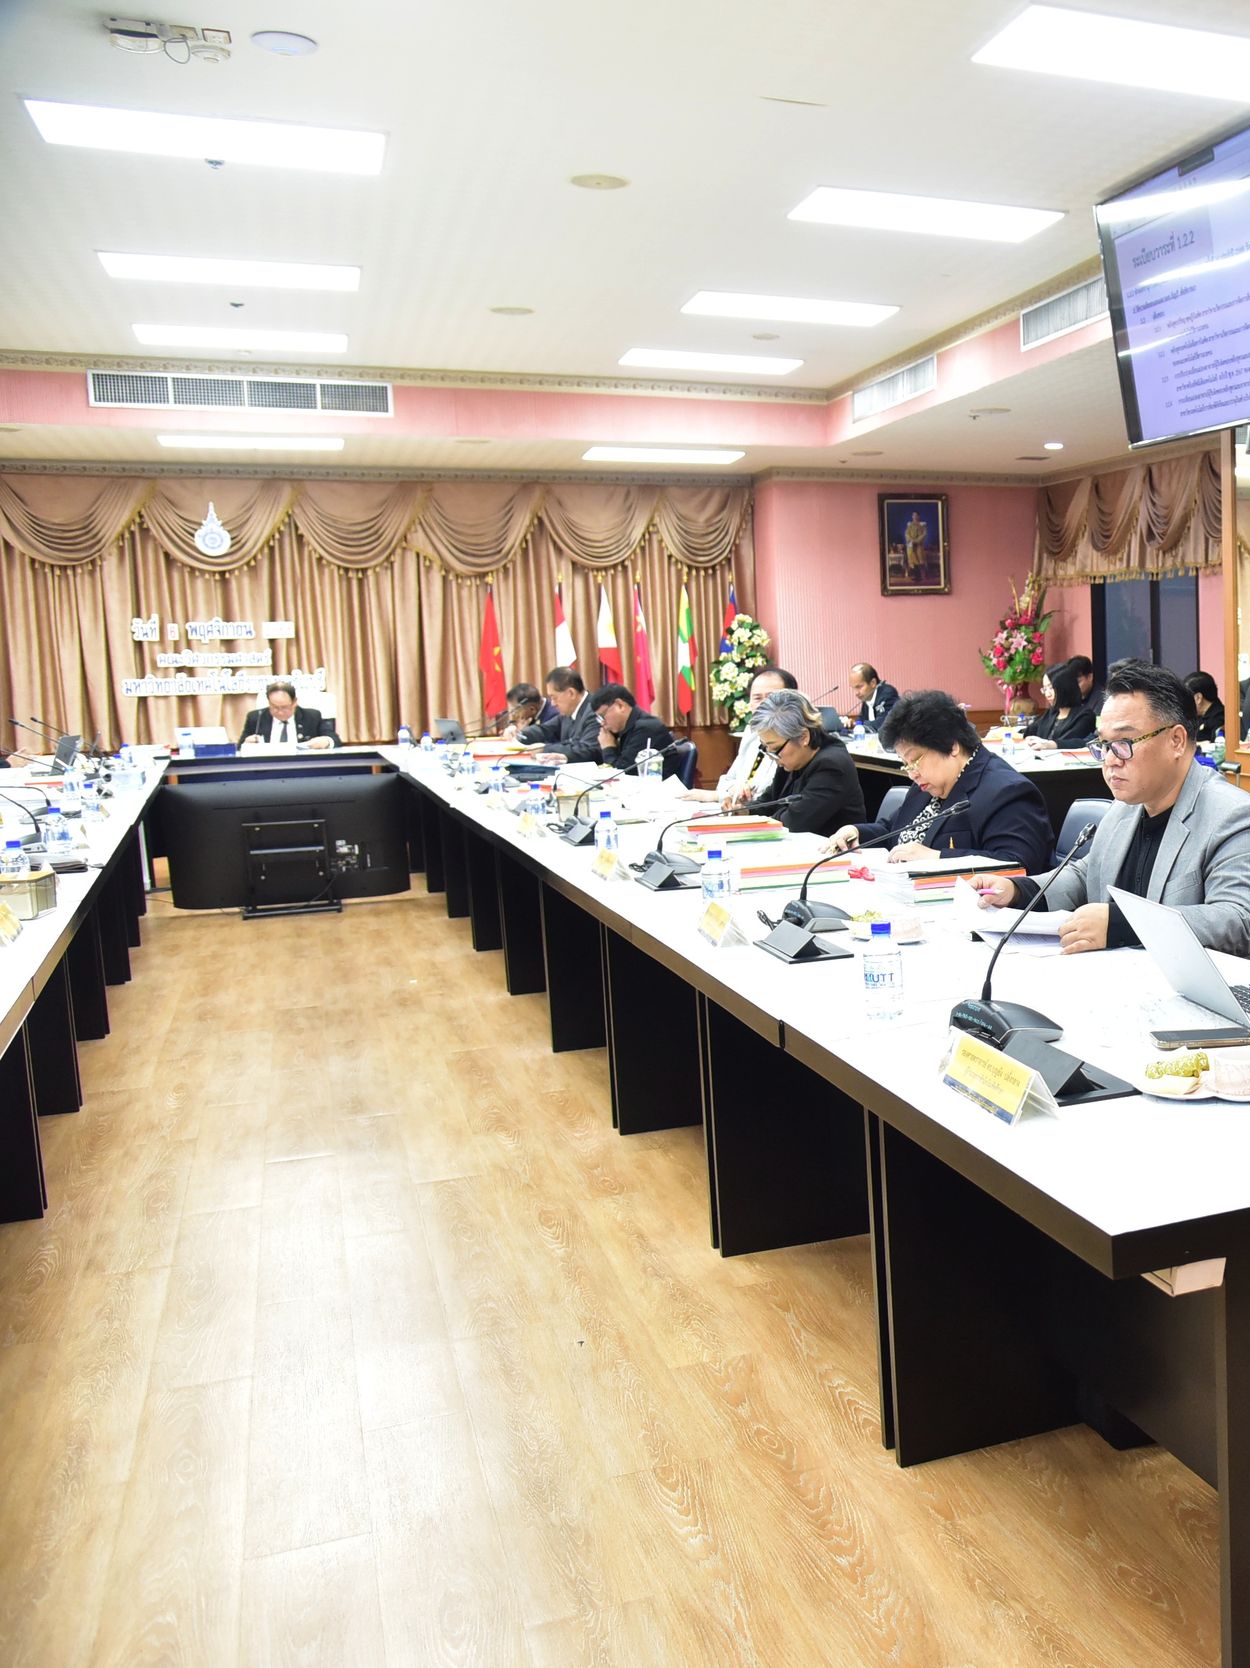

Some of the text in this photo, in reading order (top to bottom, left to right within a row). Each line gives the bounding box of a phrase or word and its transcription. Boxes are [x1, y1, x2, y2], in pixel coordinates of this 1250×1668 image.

[133, 616, 158, 640] วันที่
[188, 620, 254, 642] พฤศจิกายน
